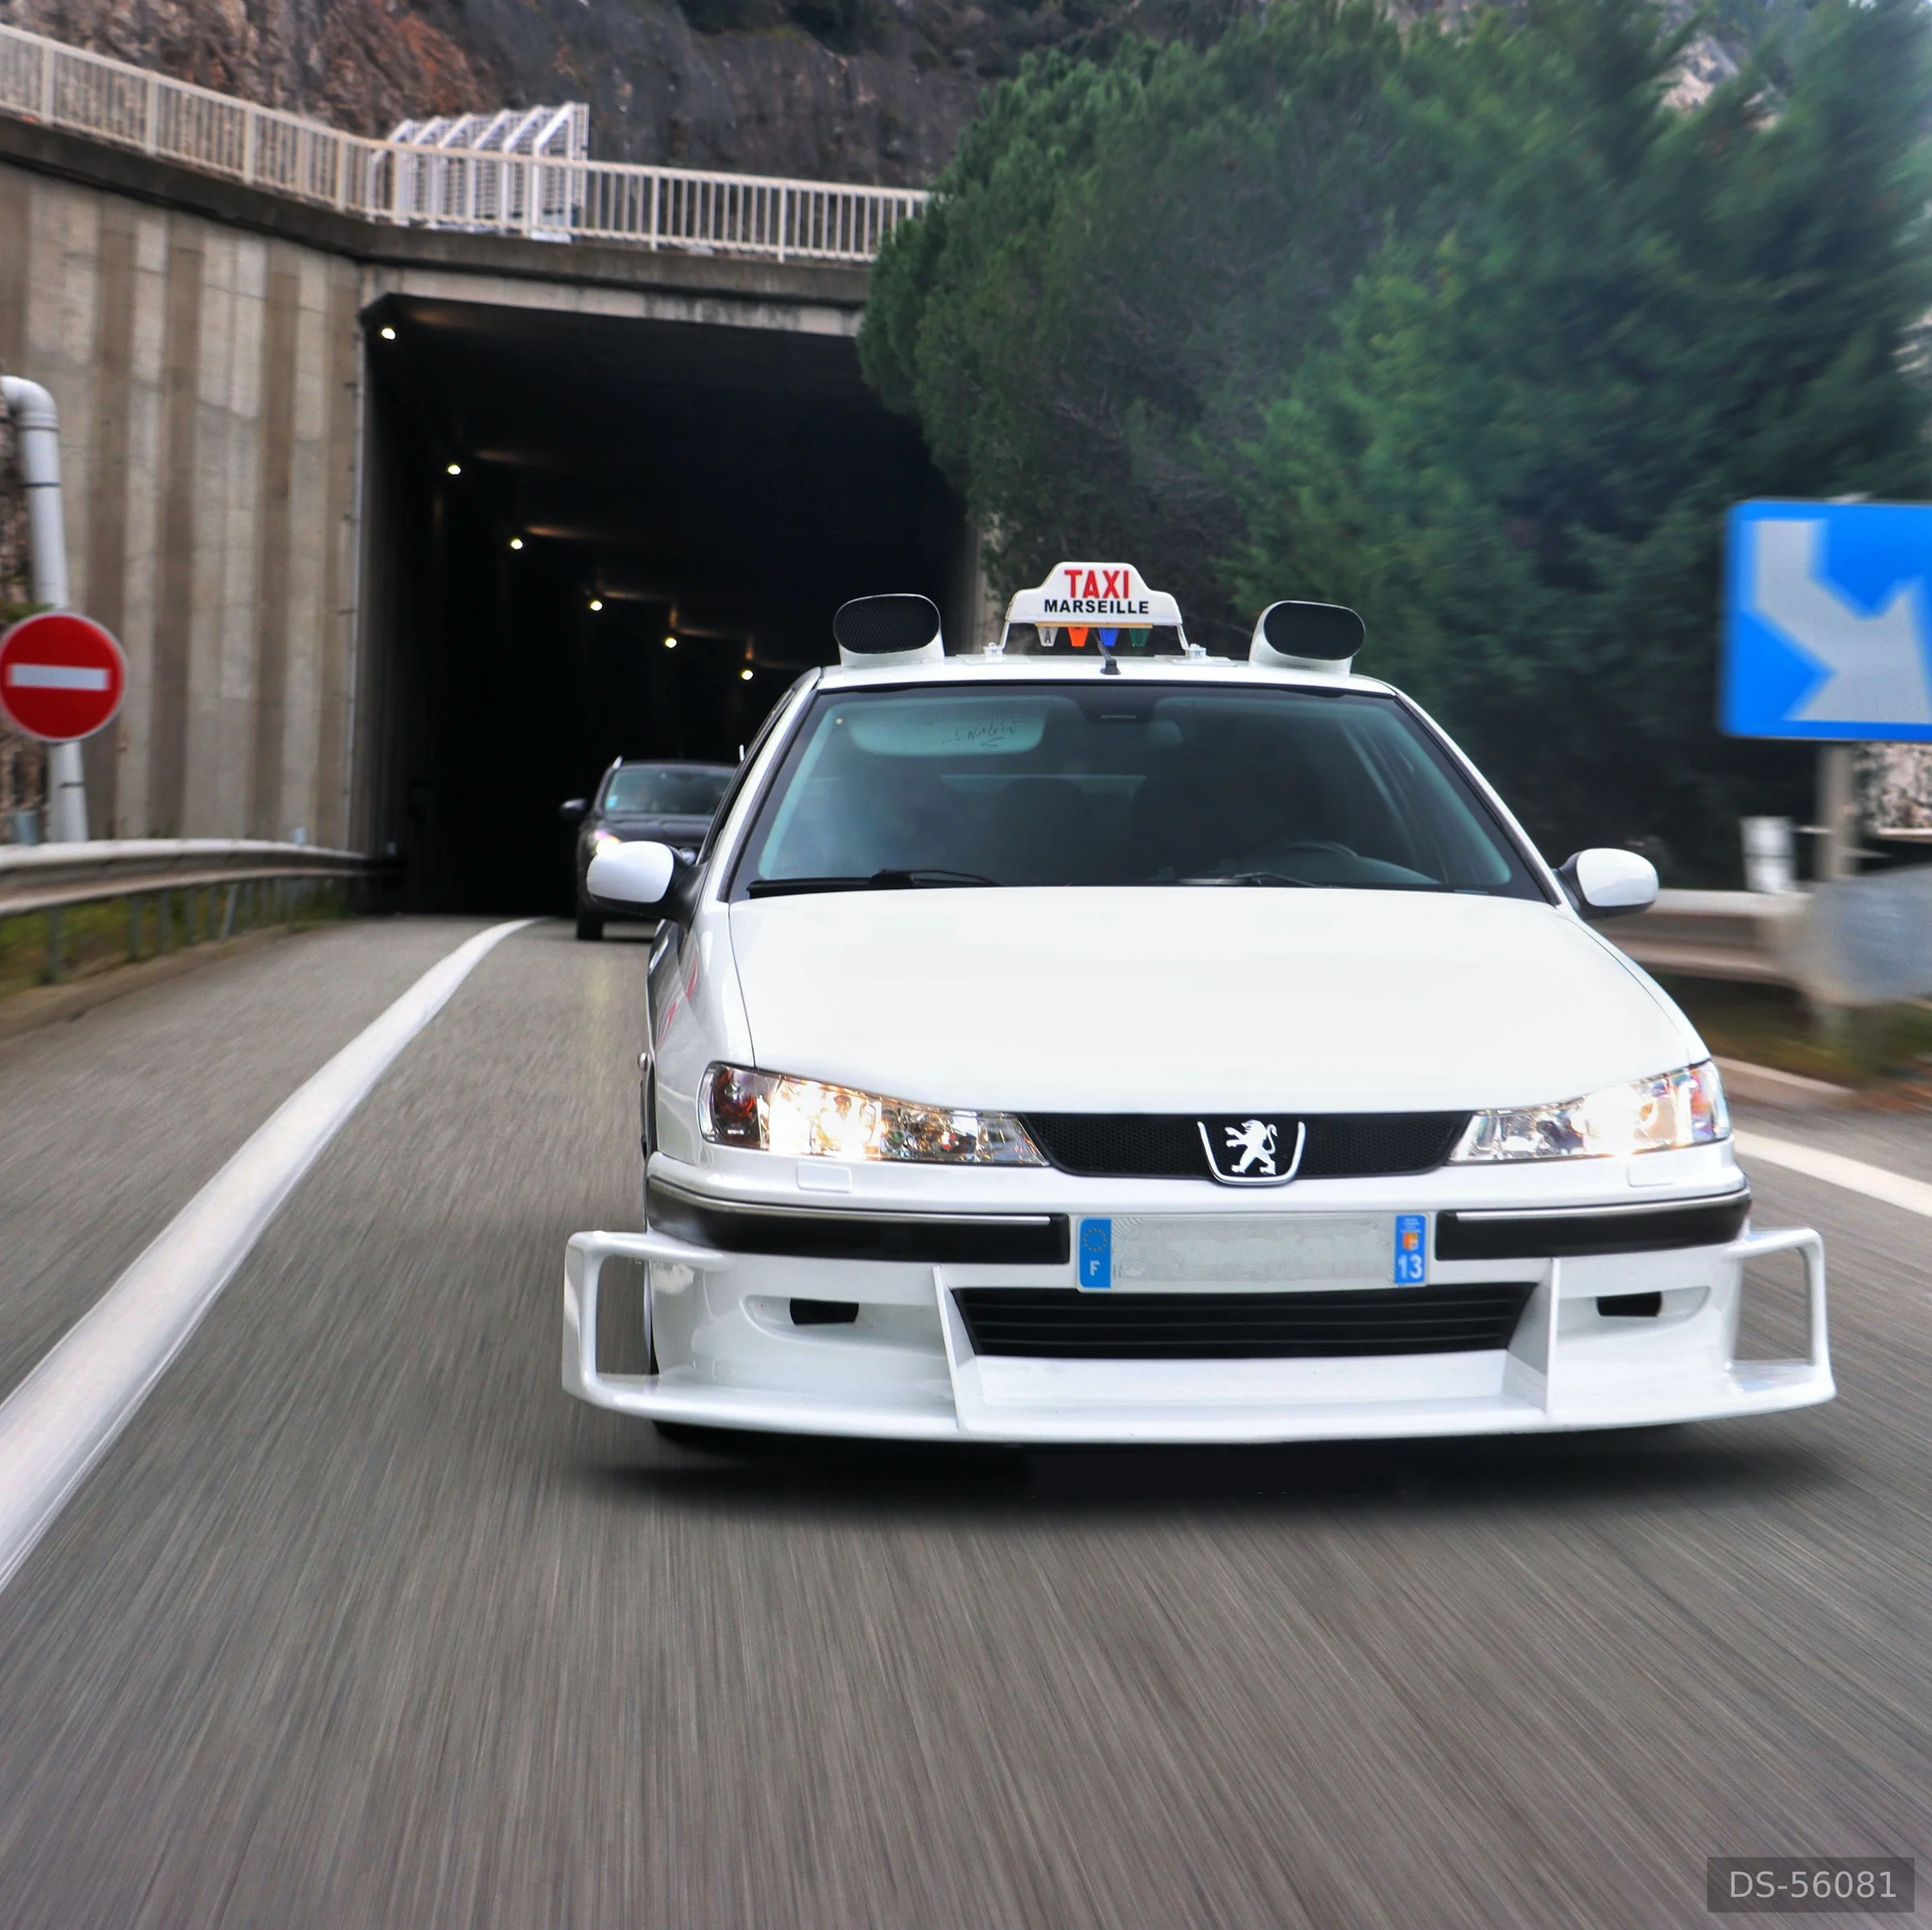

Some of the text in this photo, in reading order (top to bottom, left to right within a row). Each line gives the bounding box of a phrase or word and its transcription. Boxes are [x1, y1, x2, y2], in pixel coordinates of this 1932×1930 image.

[1064, 569, 1129, 599] TAXI
[1044, 599, 1150, 614] MARSEILLE
[1089, 1259, 1100, 1277] F
[1397, 1253, 1423, 1279] 13
